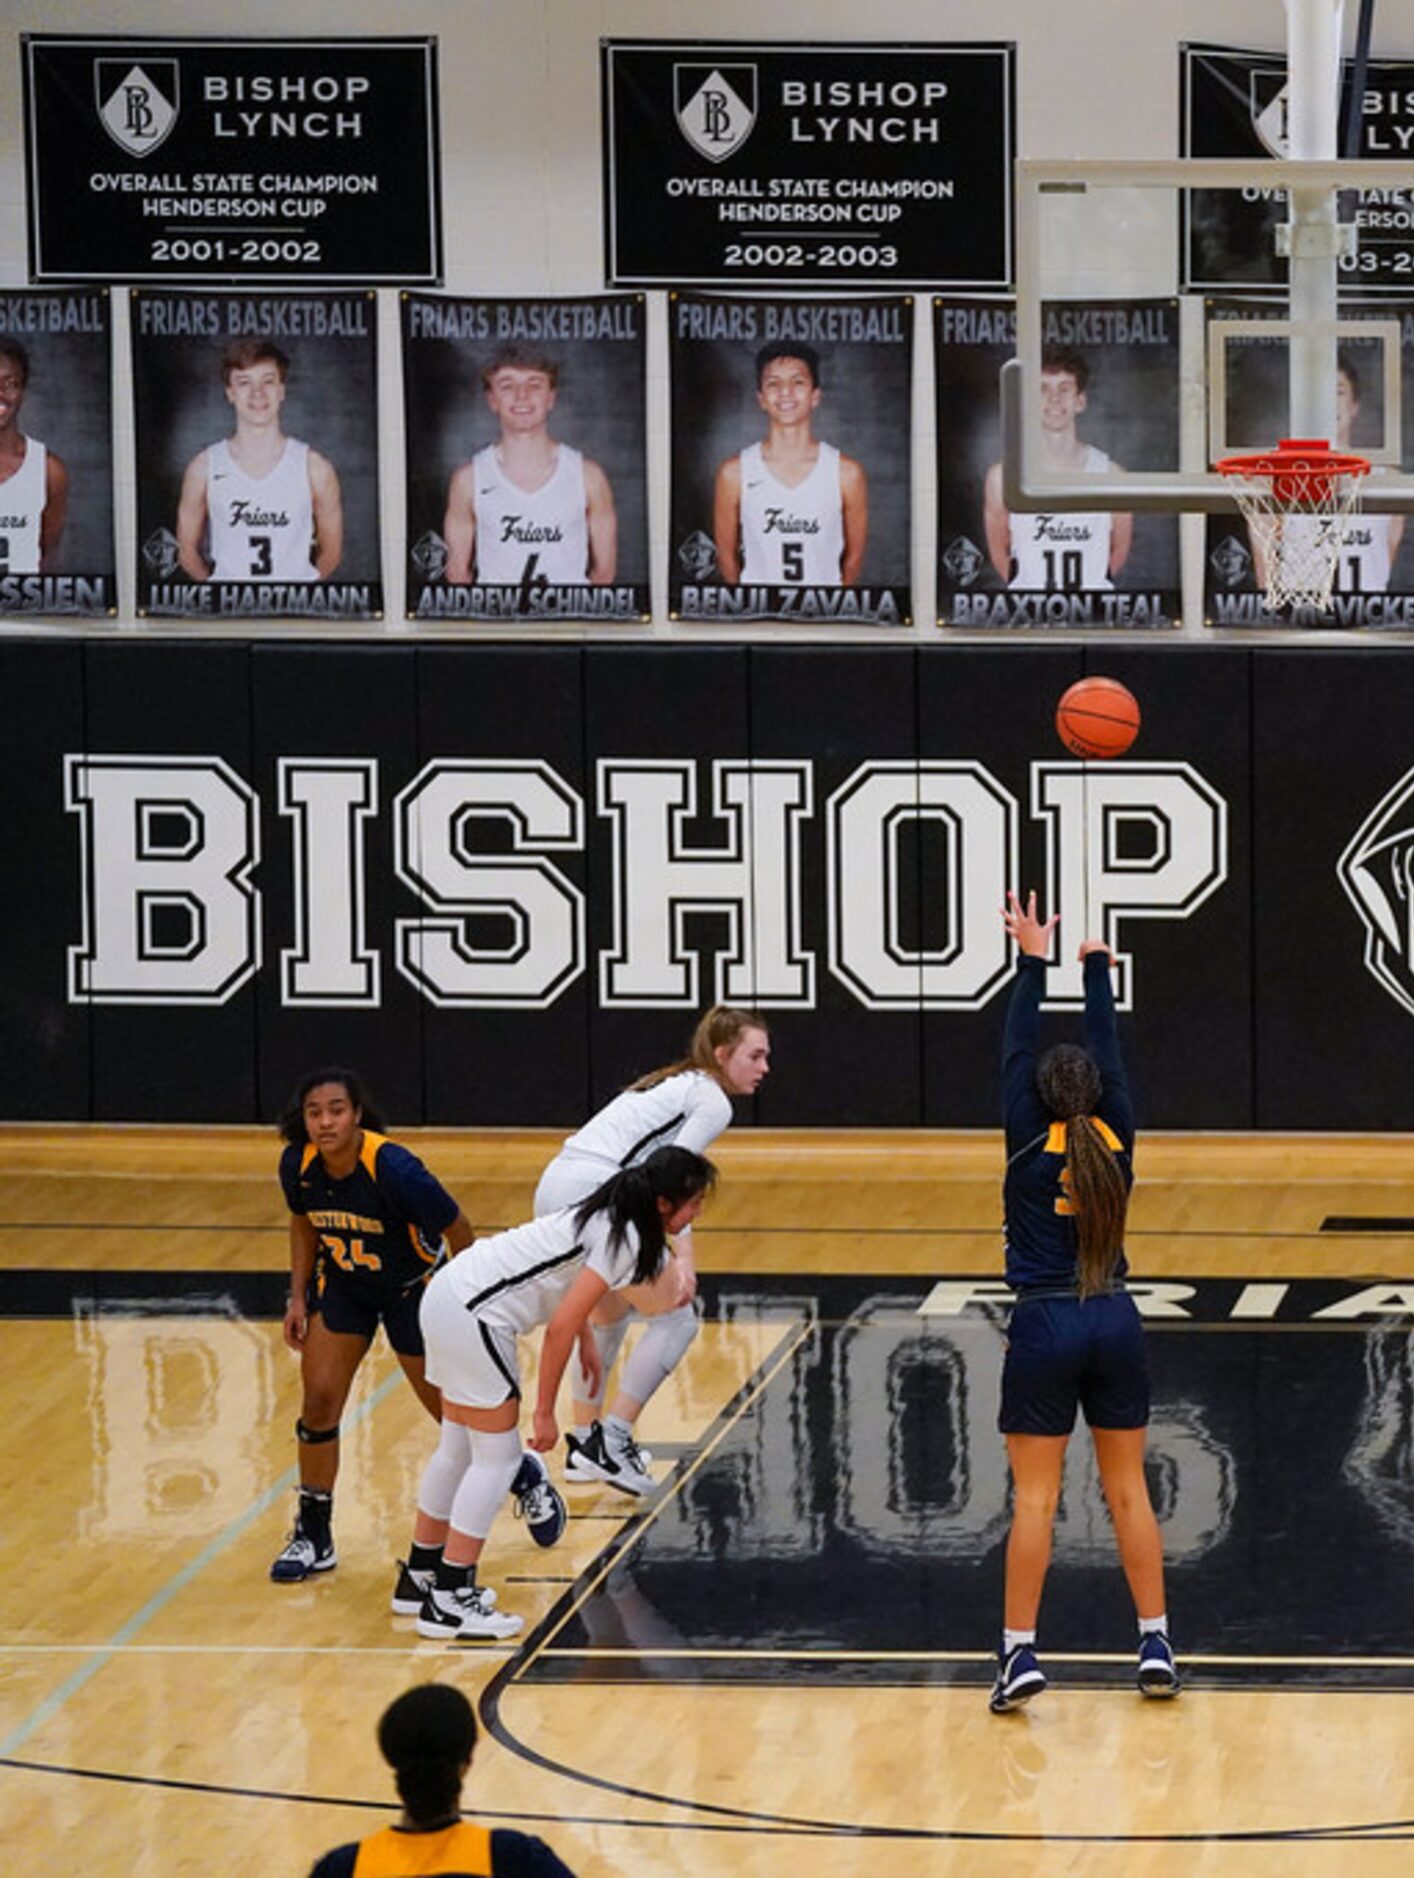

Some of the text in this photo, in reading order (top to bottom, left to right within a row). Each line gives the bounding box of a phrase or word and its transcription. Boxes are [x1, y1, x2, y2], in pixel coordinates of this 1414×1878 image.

[205, 77, 371, 102] BISHOP
[782, 82, 948, 107] BISHOP
[214, 113, 362, 137] LYNCH
[791, 119, 939, 143] LYNCH
[90, 174, 378, 193] OVERALL STATE CHAMPION
[666, 179, 954, 198] OVERALL STATE CHAMPION
[1358, 188, 1406, 205] TATE
[143, 199, 327, 218] HENDERSON CUP
[719, 204, 902, 222] HENDERSON CUP
[151, 240, 321, 262] 2001-2002
[724, 245, 898, 267] 2002-2003
[140, 302, 367, 335] FRIARS BASKETBALL
[410, 302, 636, 339] FRIARS BASKETBALL
[678, 303, 903, 341] FRIARS BASKETBALL
[1045, 309, 1168, 343] ASKETBALL
[229, 500, 290, 529] Friars
[763, 508, 821, 534] Friars
[500, 515, 563, 543] Friars
[1033, 516, 1092, 542] Friars
[249, 536, 272, 576] 3
[782, 542, 804, 581] 5
[1044, 551, 1083, 590] 10
[151, 584, 370, 612] LUKE HARTMANN
[417, 586, 638, 614] ANDREW SCHINDEL
[681, 586, 899, 622] BENJI ZAVALA
[951, 593, 1166, 627] BRAXTON TEAL
[63, 753, 1228, 1011] BISHOP
